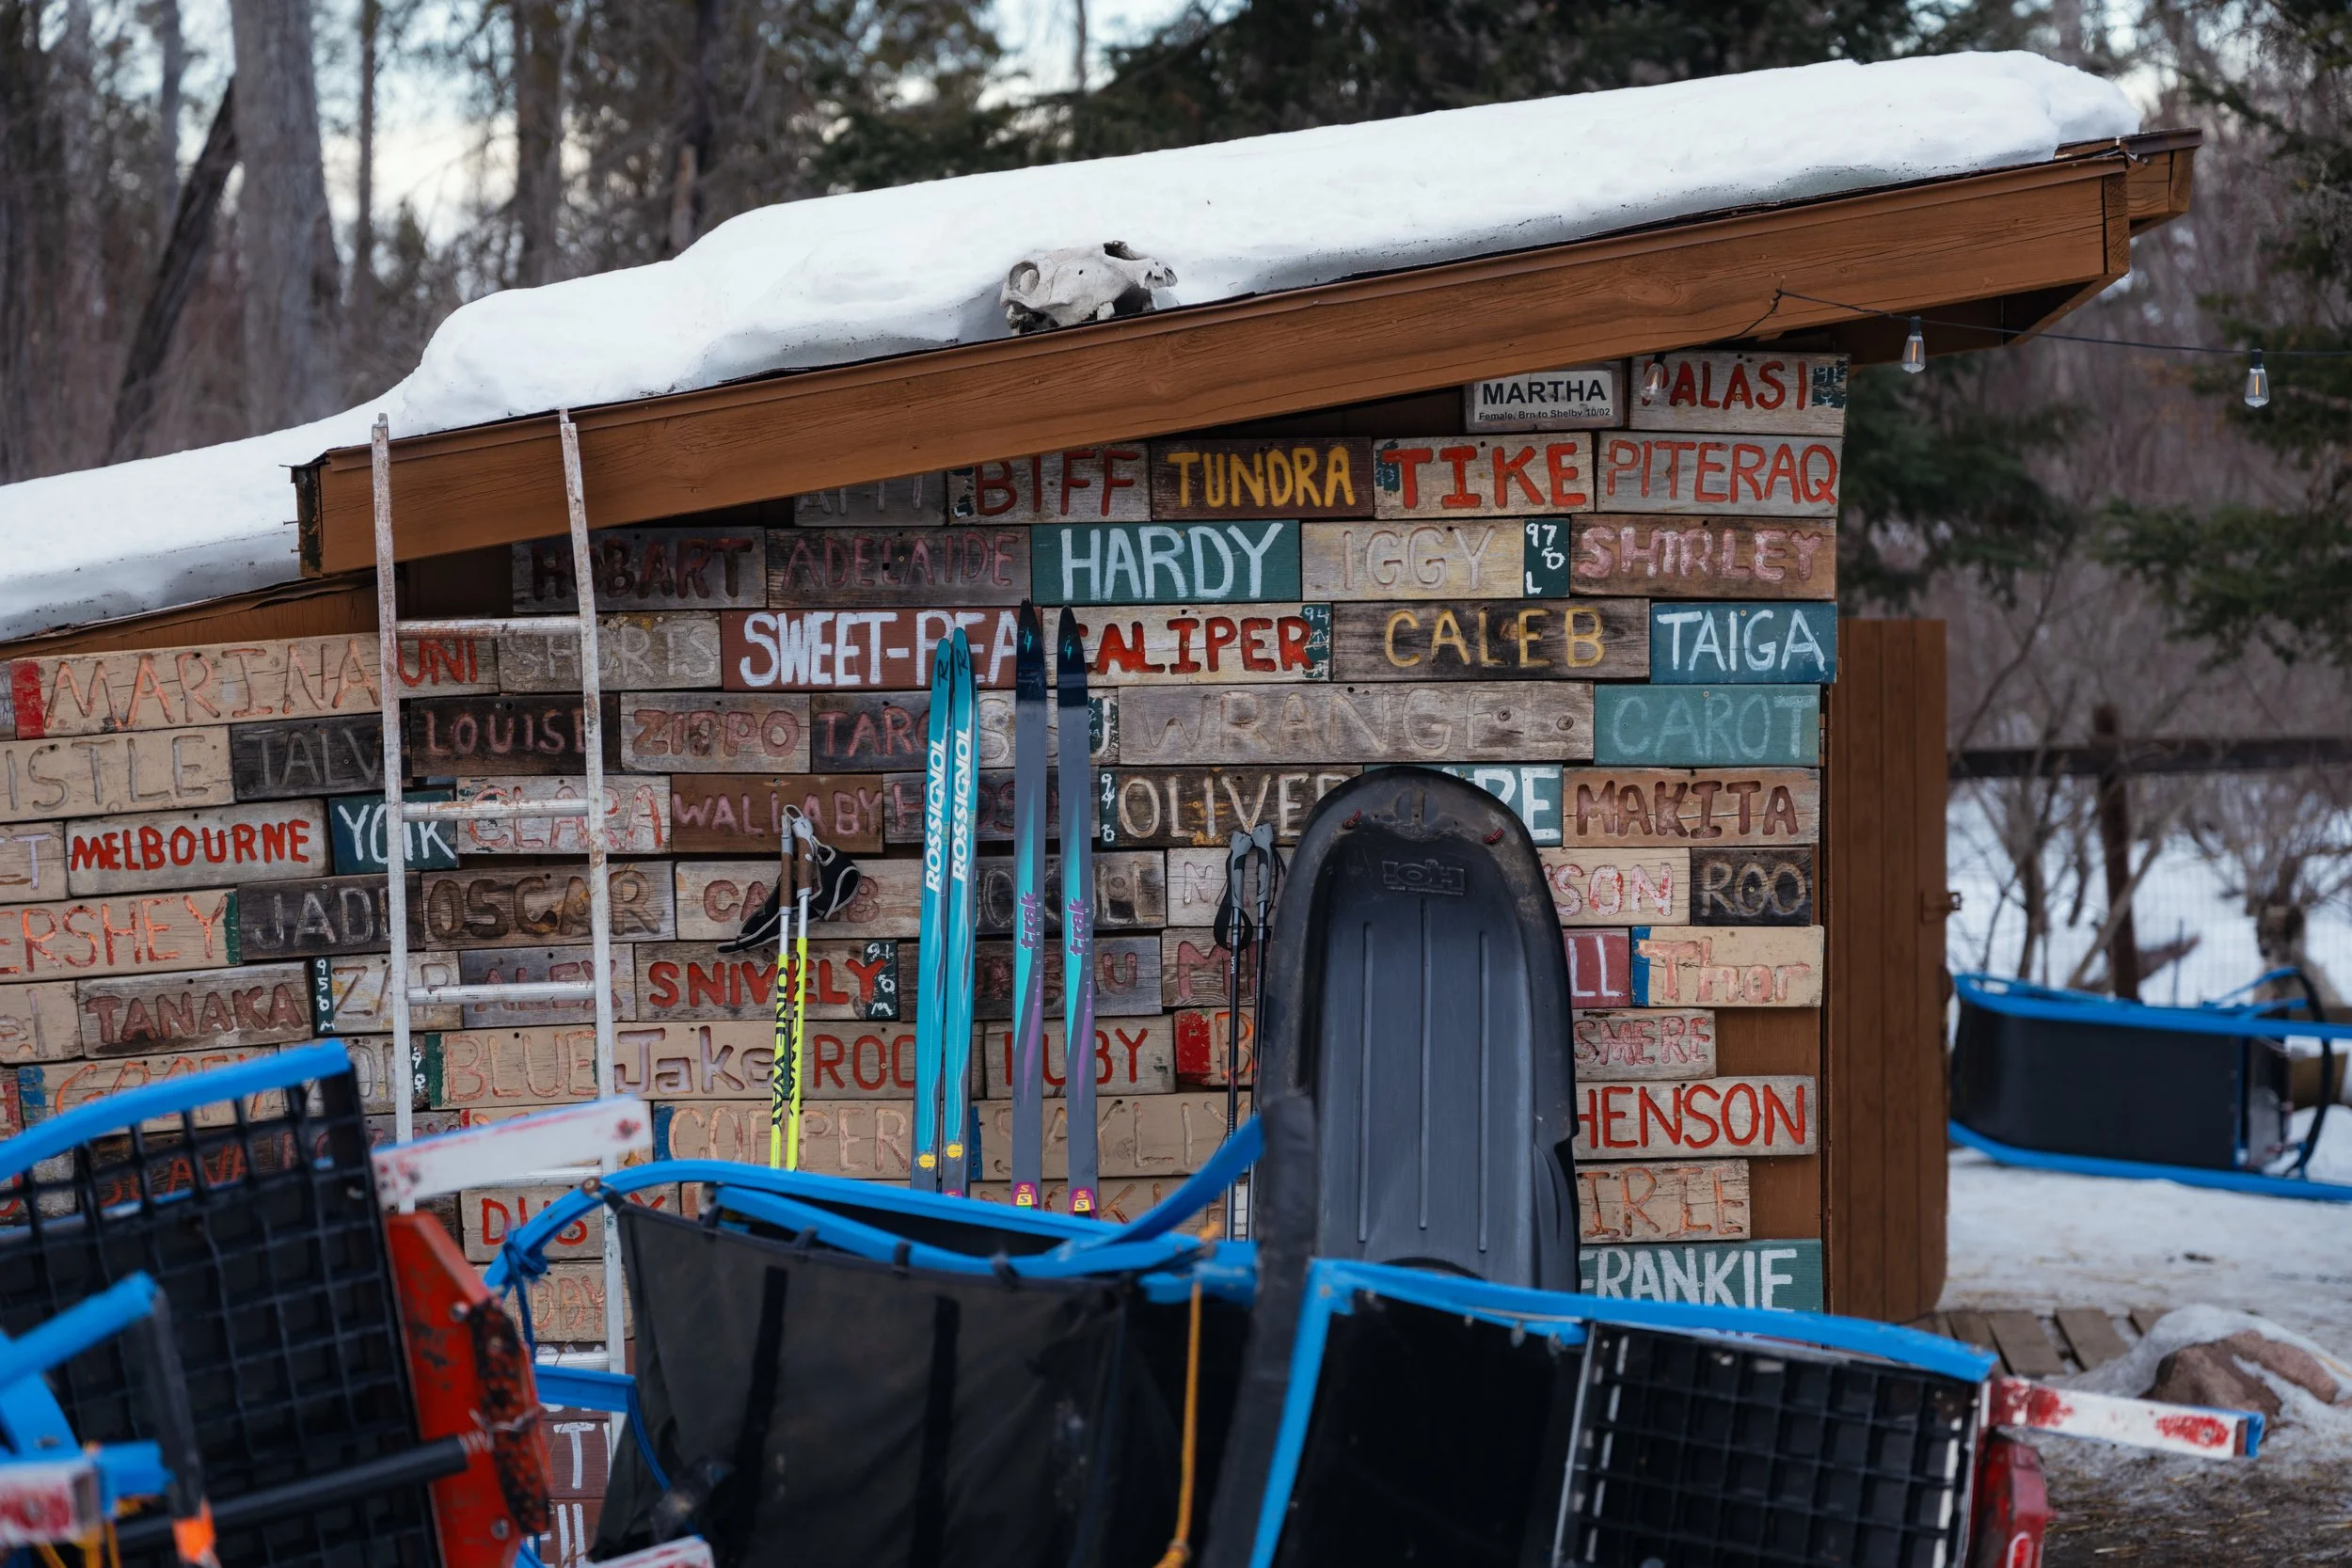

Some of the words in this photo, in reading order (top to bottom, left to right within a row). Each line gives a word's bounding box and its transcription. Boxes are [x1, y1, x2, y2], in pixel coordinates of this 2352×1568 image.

[1483, 380, 1607, 404] MARTHA
[1518, 411, 1536, 420] Brn
[1586, 408, 1610, 417] 10/02
[976, 451, 1139, 517] BIFF
[1167, 446, 1356, 508] TUNDRA
[1381, 442, 1587, 509] TIKE
[1607, 439, 1837, 505] PITERAQ
[782, 531, 1019, 591] ADELAIDE
[1061, 523, 1284, 600] HARDY
[1343, 526, 1496, 590] IGGY
[1578, 526, 1823, 584] SHIRLEY
[1080, 616, 1315, 675] ALIPER
[1384, 607, 1605, 669] CALEB
[1657, 609, 1826, 673] TAIGA
[43, 639, 382, 730] MARINA
[633, 709, 800, 757] ZIPPO
[818, 706, 930, 757] TAR
[1133, 688, 1569, 754] WRANGEL
[1614, 692, 1817, 759] CAROT
[926, 738, 945, 894] ROSSIGNOL
[952, 727, 970, 882] ROSSIGNOL
[1576, 780, 1799, 839] MAKITA
[71, 819, 311, 871] MELBOURNE
[428, 870, 660, 938] OSCAR
[1544, 863, 1672, 917] SON
[1702, 862, 1805, 916] ROO
[86, 983, 304, 1043] TANAKA
[445, 1030, 597, 1102] BLUE
[614, 1025, 776, 1094] Jake
[669, 1106, 911, 1172] COPPER
